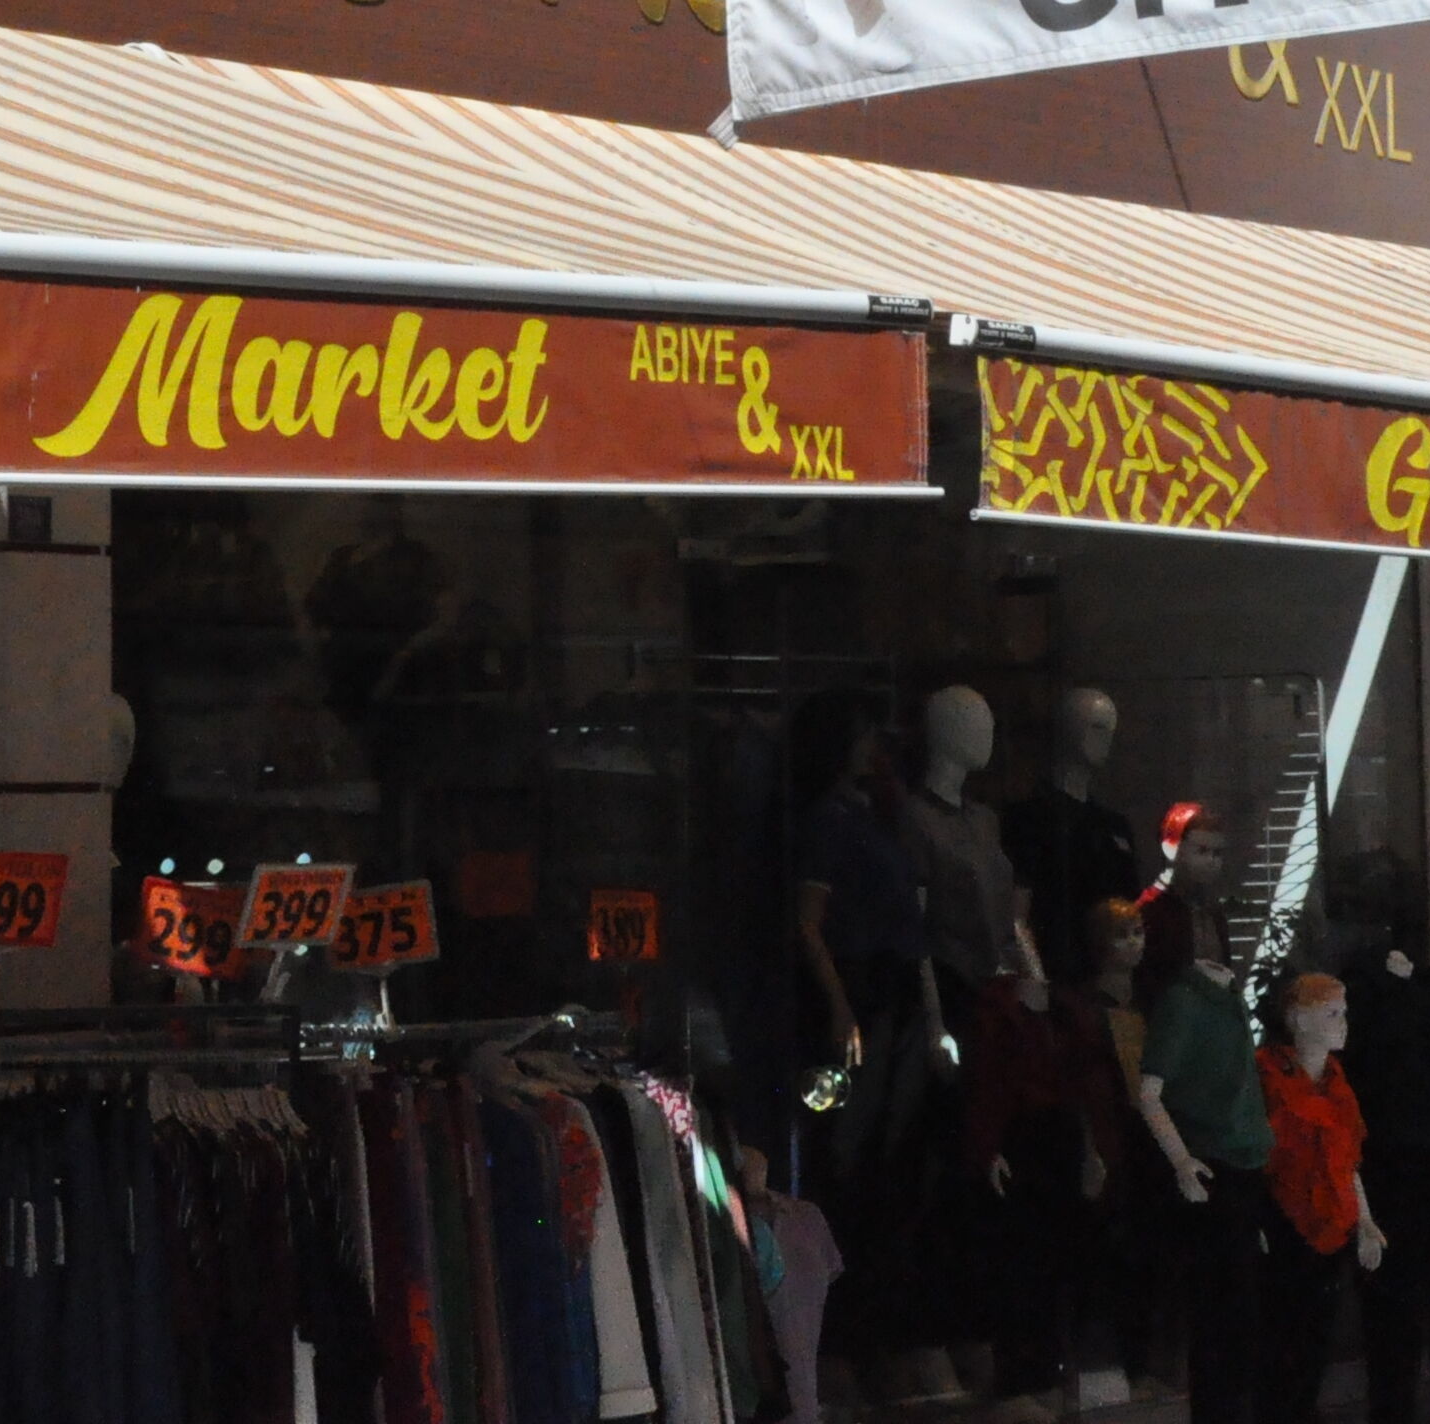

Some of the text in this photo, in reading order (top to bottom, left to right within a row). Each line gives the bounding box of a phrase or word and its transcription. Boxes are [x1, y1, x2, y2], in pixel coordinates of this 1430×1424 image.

[1314, 55, 1414, 163] XXL
[32, 292, 549, 458] Market
[629, 323, 736, 385] ABIYE
[737, 345, 782, 454] &
[790, 424, 855, 481] XXL
[147, 907, 232, 967] 299
[252, 887, 332, 940] 399
[336, 906, 418, 962] 375
